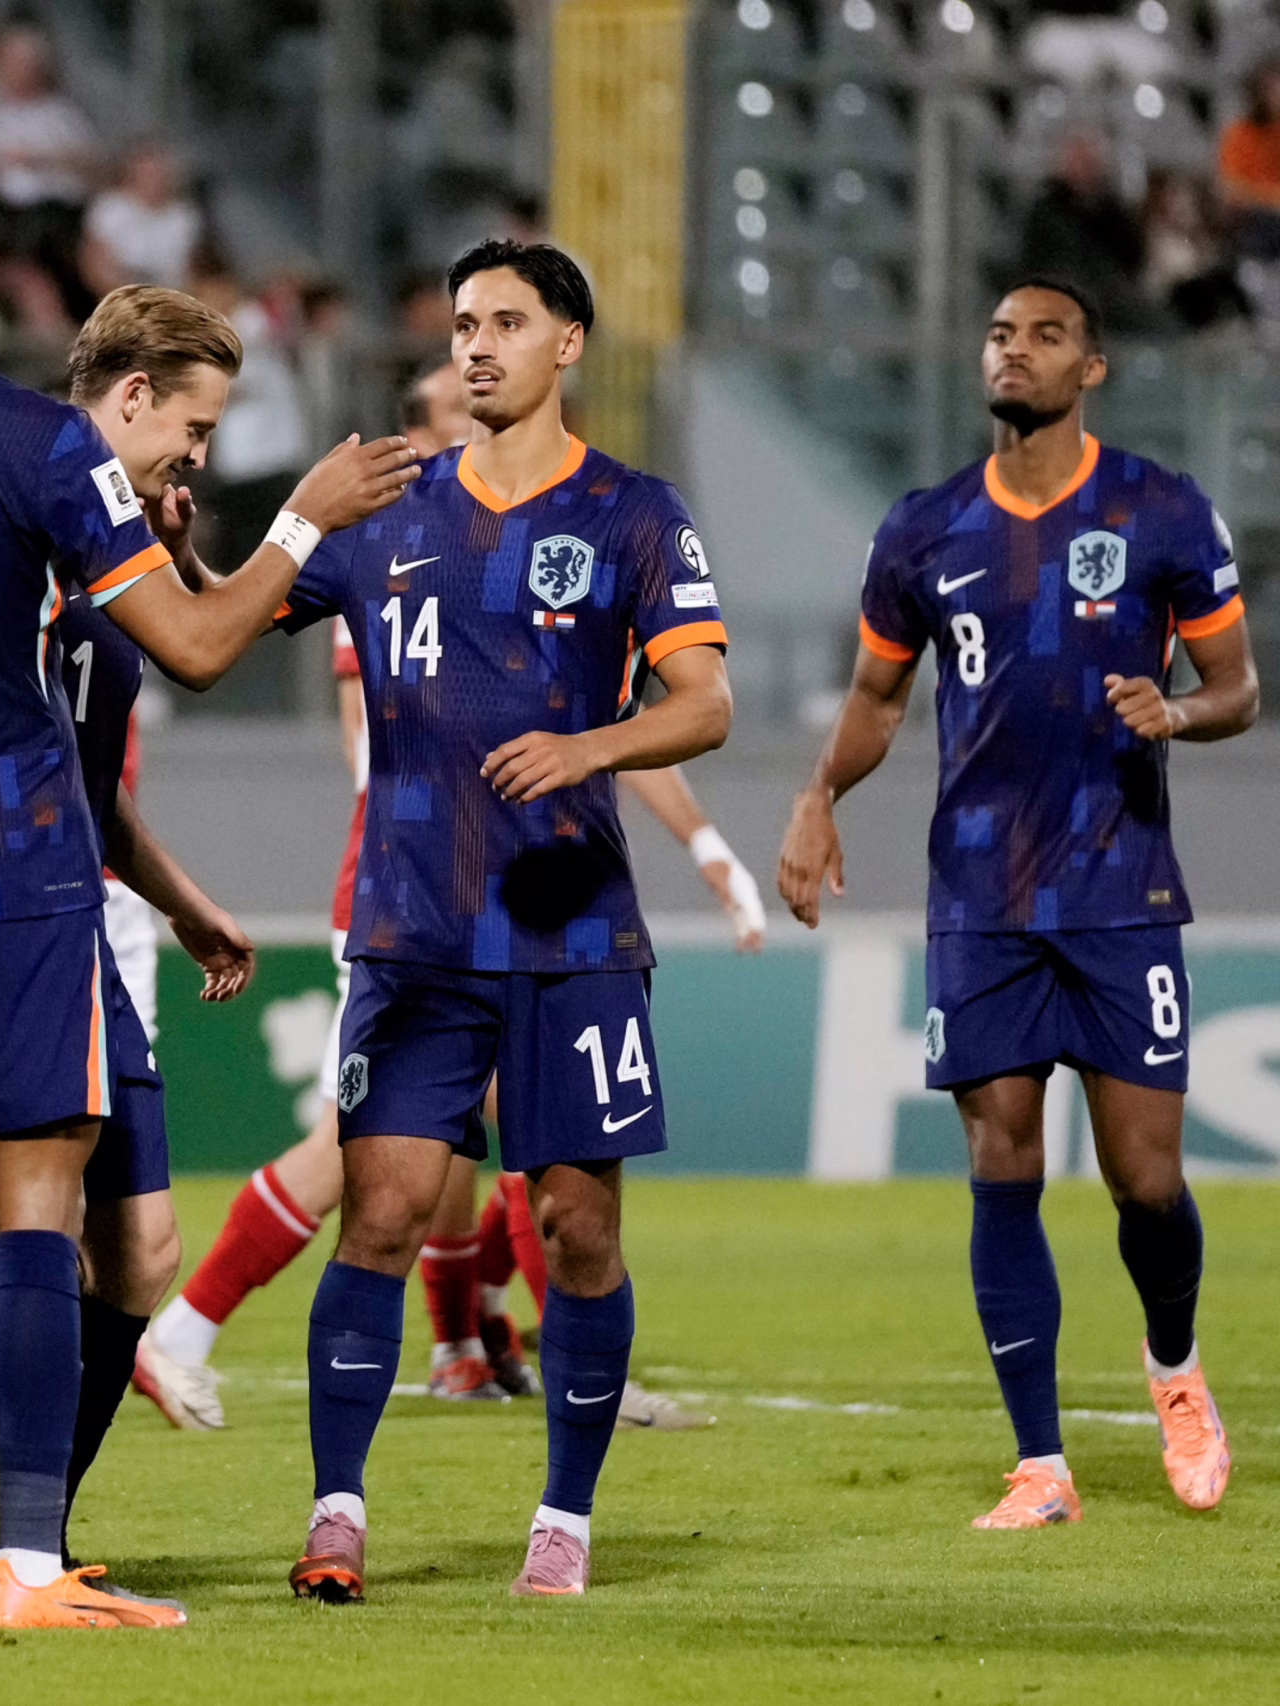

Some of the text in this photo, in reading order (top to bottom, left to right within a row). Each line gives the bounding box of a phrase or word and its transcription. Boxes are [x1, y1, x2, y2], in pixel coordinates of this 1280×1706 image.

[380, 596, 443, 677] 14
[950, 612, 986, 687] 8
[60, 640, 94, 723] 1
[1146, 964, 1181, 1039] 8
[573, 1016, 652, 1104] 14
